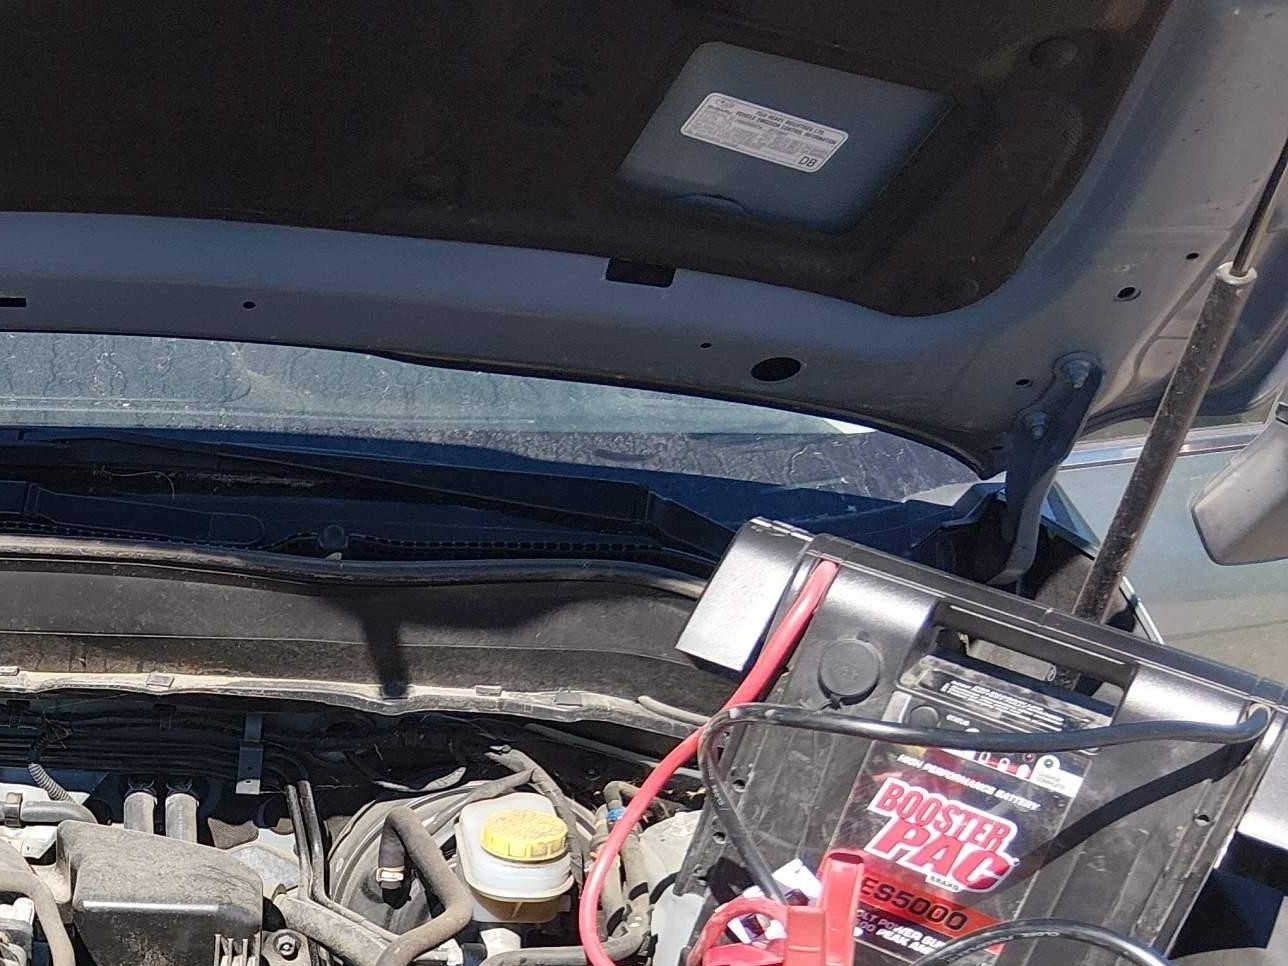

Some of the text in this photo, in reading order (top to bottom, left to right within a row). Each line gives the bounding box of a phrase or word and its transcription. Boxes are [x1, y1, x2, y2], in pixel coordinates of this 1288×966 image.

[798, 155, 817, 167] DB
[897, 753, 1041, 810] HIGH PERFORMANCE BATTERY
[874, 780, 1013, 852] BOOSTER
[873, 817, 1012, 891] PAC
[861, 877, 969, 931] ES5000
[877, 917, 922, 940] POWER
[875, 927, 911, 947] PEAK
